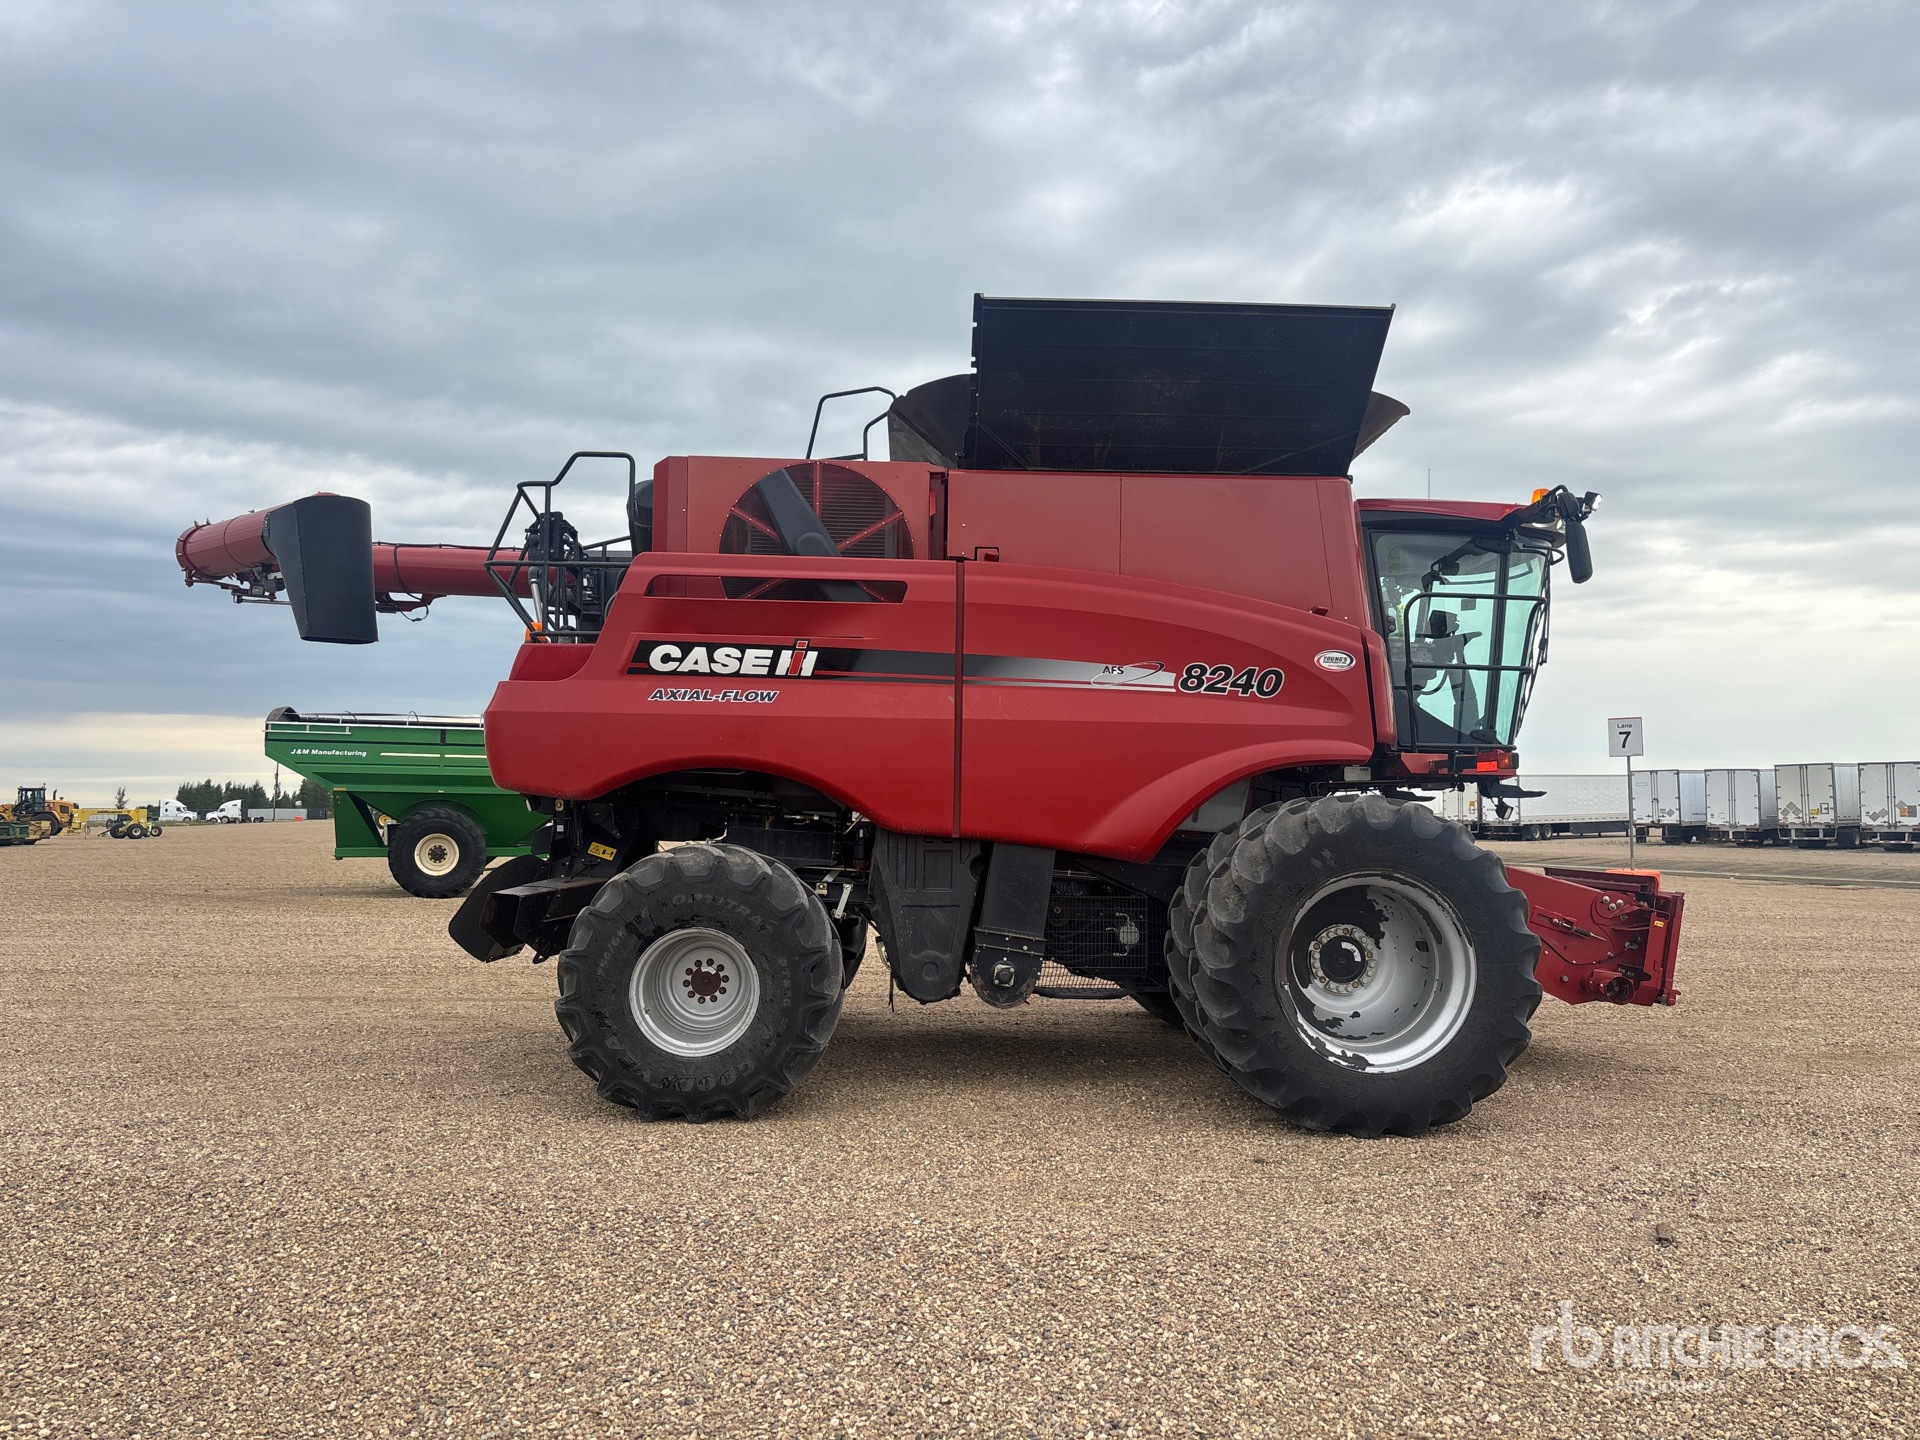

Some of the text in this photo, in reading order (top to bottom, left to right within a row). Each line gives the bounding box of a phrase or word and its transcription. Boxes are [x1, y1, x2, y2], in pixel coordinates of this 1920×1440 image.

[648, 644, 774, 675] CASE
[1102, 662, 1285, 698] AFS 8240
[648, 688, 780, 703] AXIAL-FLOW
[1618, 731, 1631, 749] 7
[311, 748, 367, 757] Manufacturing
